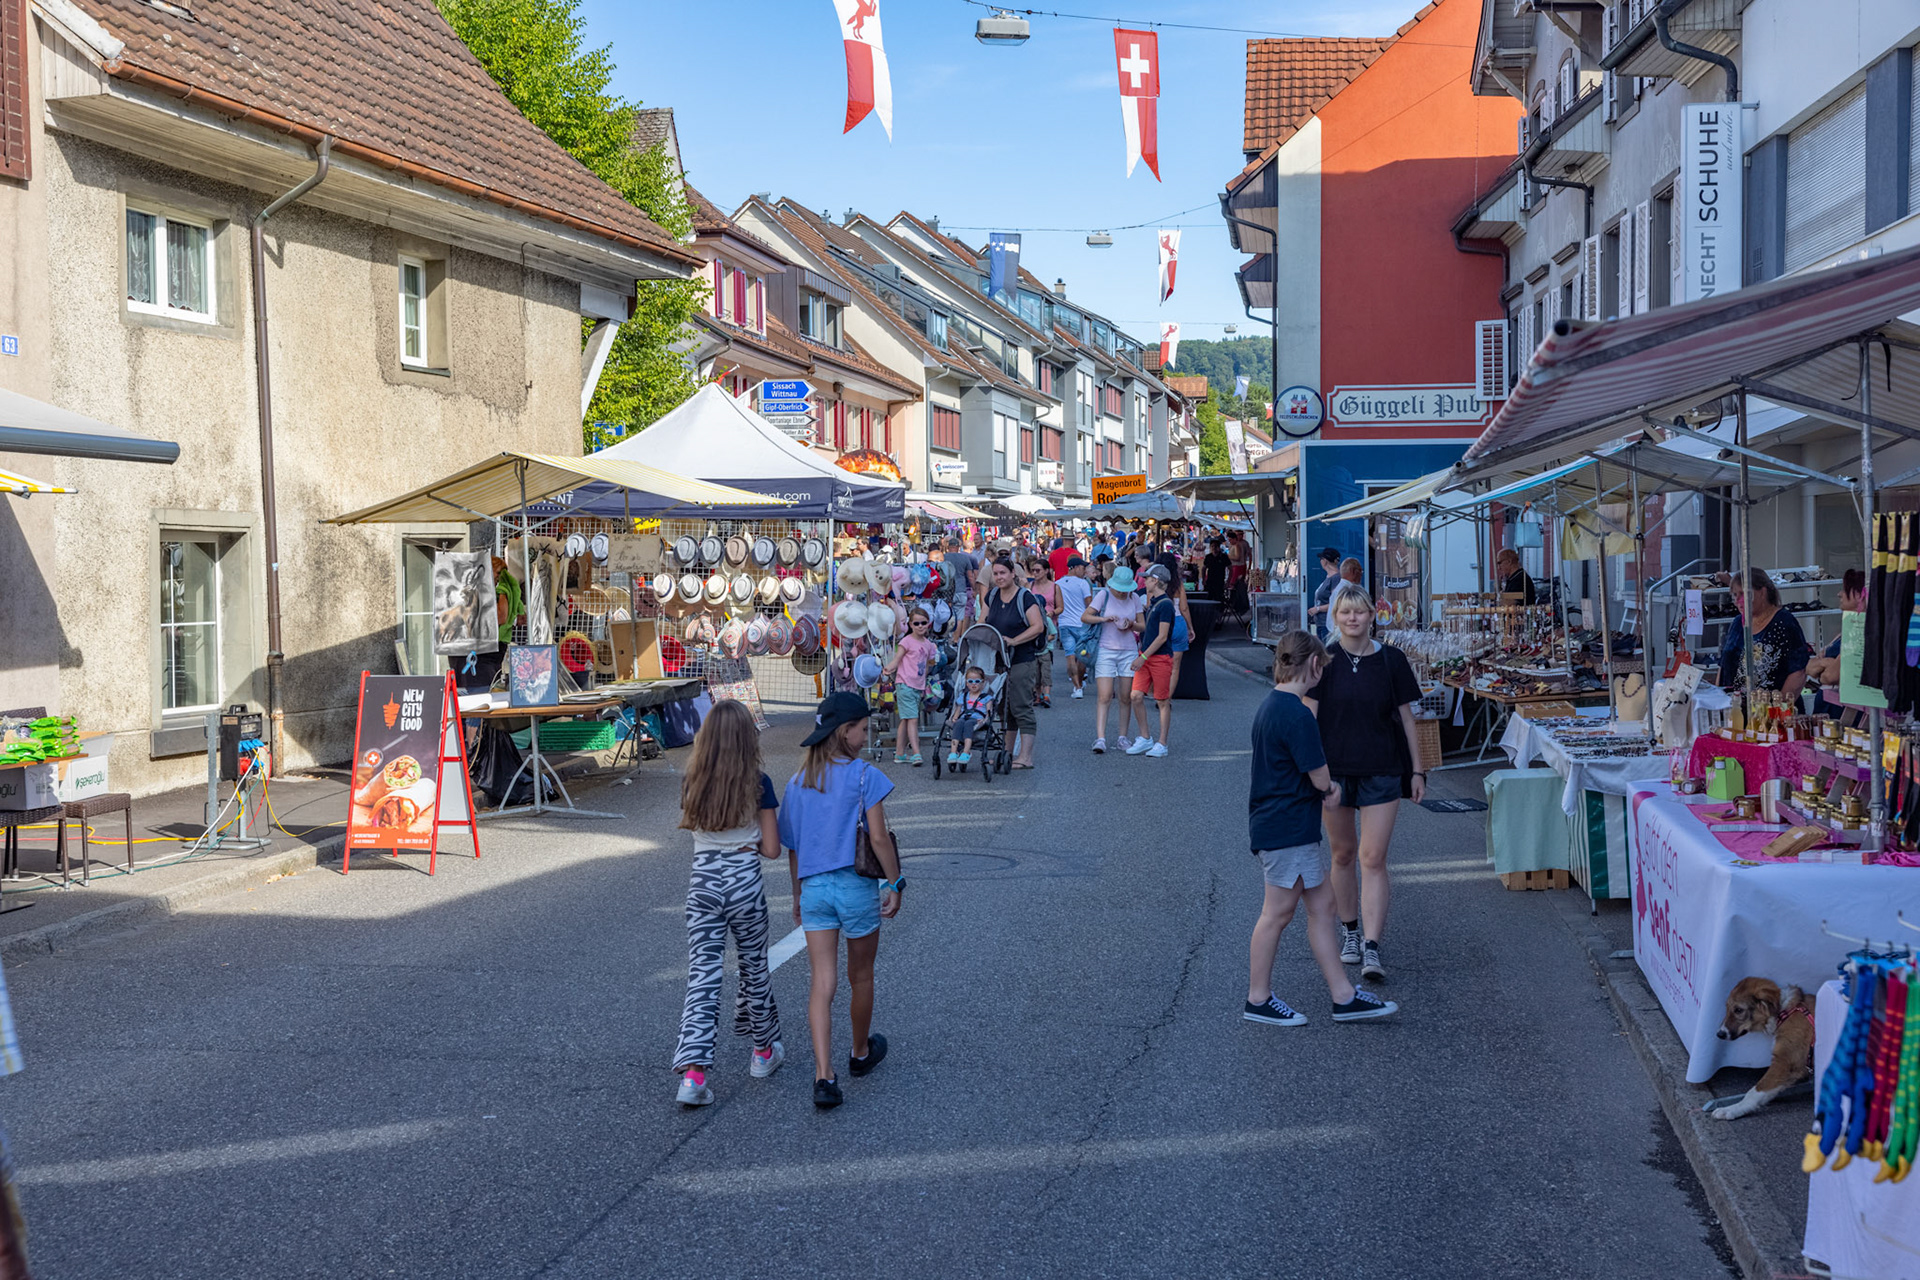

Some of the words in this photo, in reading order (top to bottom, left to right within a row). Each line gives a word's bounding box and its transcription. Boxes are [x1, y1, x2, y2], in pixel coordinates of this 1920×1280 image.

[1721, 142, 1733, 171] und
[1698, 110, 1719, 222] SCHUHE
[5, 337, 16, 353] 63
[772, 382, 796, 390] Sissach
[771, 390, 798, 398] Wittnau
[765, 403, 804, 412] Gipf-Oberfrick
[1339, 395, 1425, 419] Güggeli
[1433, 394, 1481, 418] Pub
[1096, 479, 1141, 490] Magenbrot
[403, 688, 425, 702] NEW
[400, 716, 423, 731] FOOD
[1660, 828, 1679, 896] den
[1648, 881, 1671, 962] Senf
